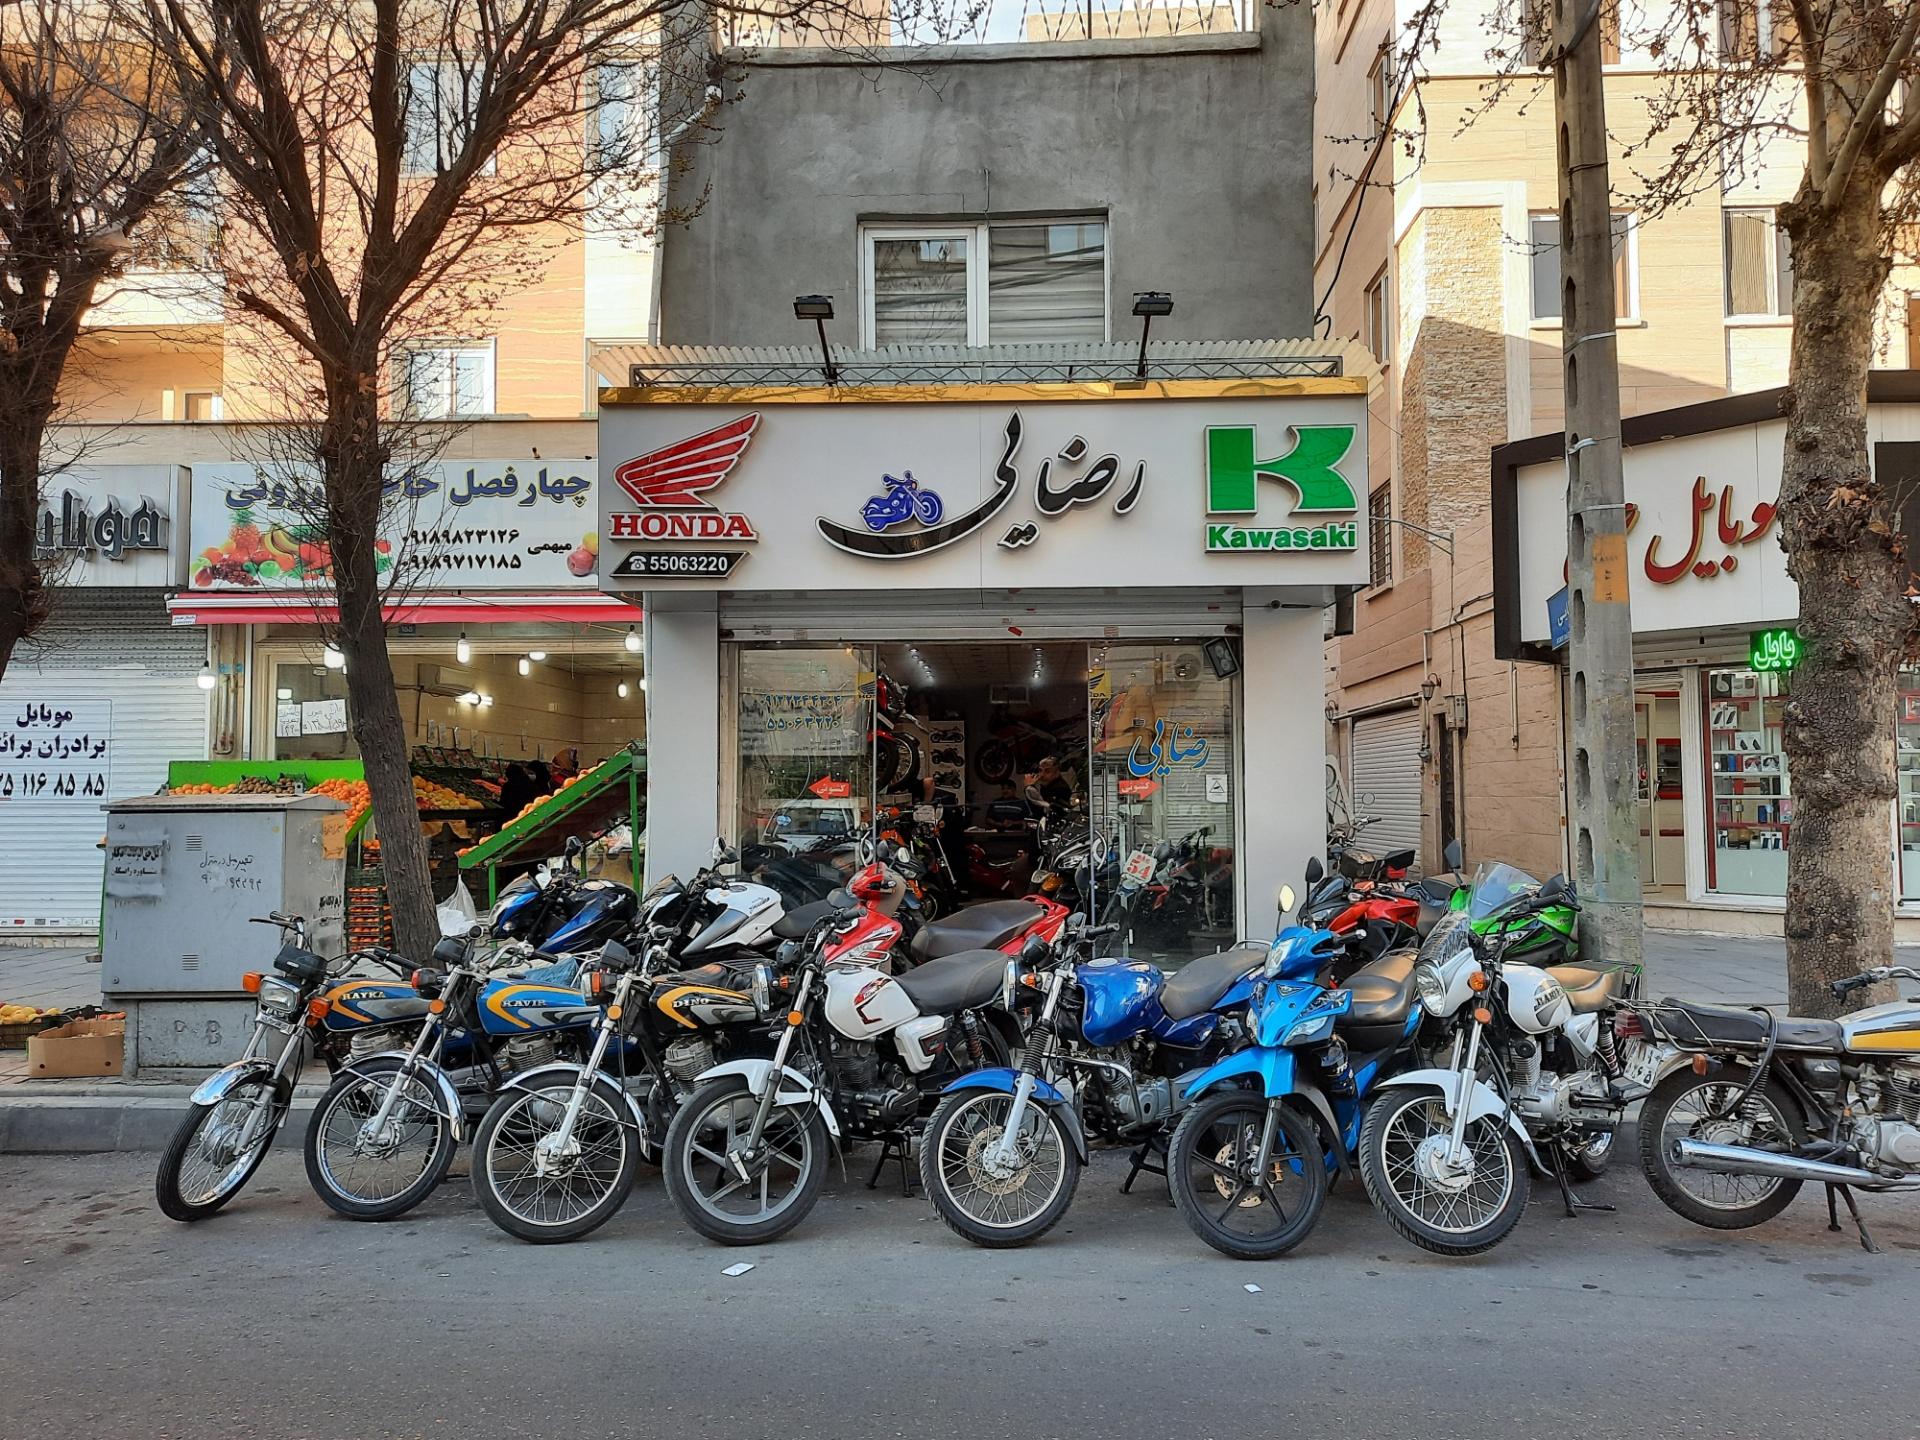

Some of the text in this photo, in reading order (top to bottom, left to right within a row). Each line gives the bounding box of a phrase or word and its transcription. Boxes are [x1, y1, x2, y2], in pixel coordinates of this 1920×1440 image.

[36, 489, 167, 560] موبای
[610, 513, 755, 538] HONDA
[1207, 524, 1357, 550] Kawasaki
[1644, 476, 1780, 584] وبایل
[649, 555, 729, 572] 55063220
[1754, 631, 1796, 669] بایل
[16, 703, 73, 728] موبایل
[38, 733, 106, 759] برادران
[23, 772, 47, 796] ۱۱۶
[54, 772, 76, 796] ۸۵
[83, 772, 105, 796] ۸۵
[342, 991, 386, 1000] RAYKA
[672, 997, 709, 1008] DINO
